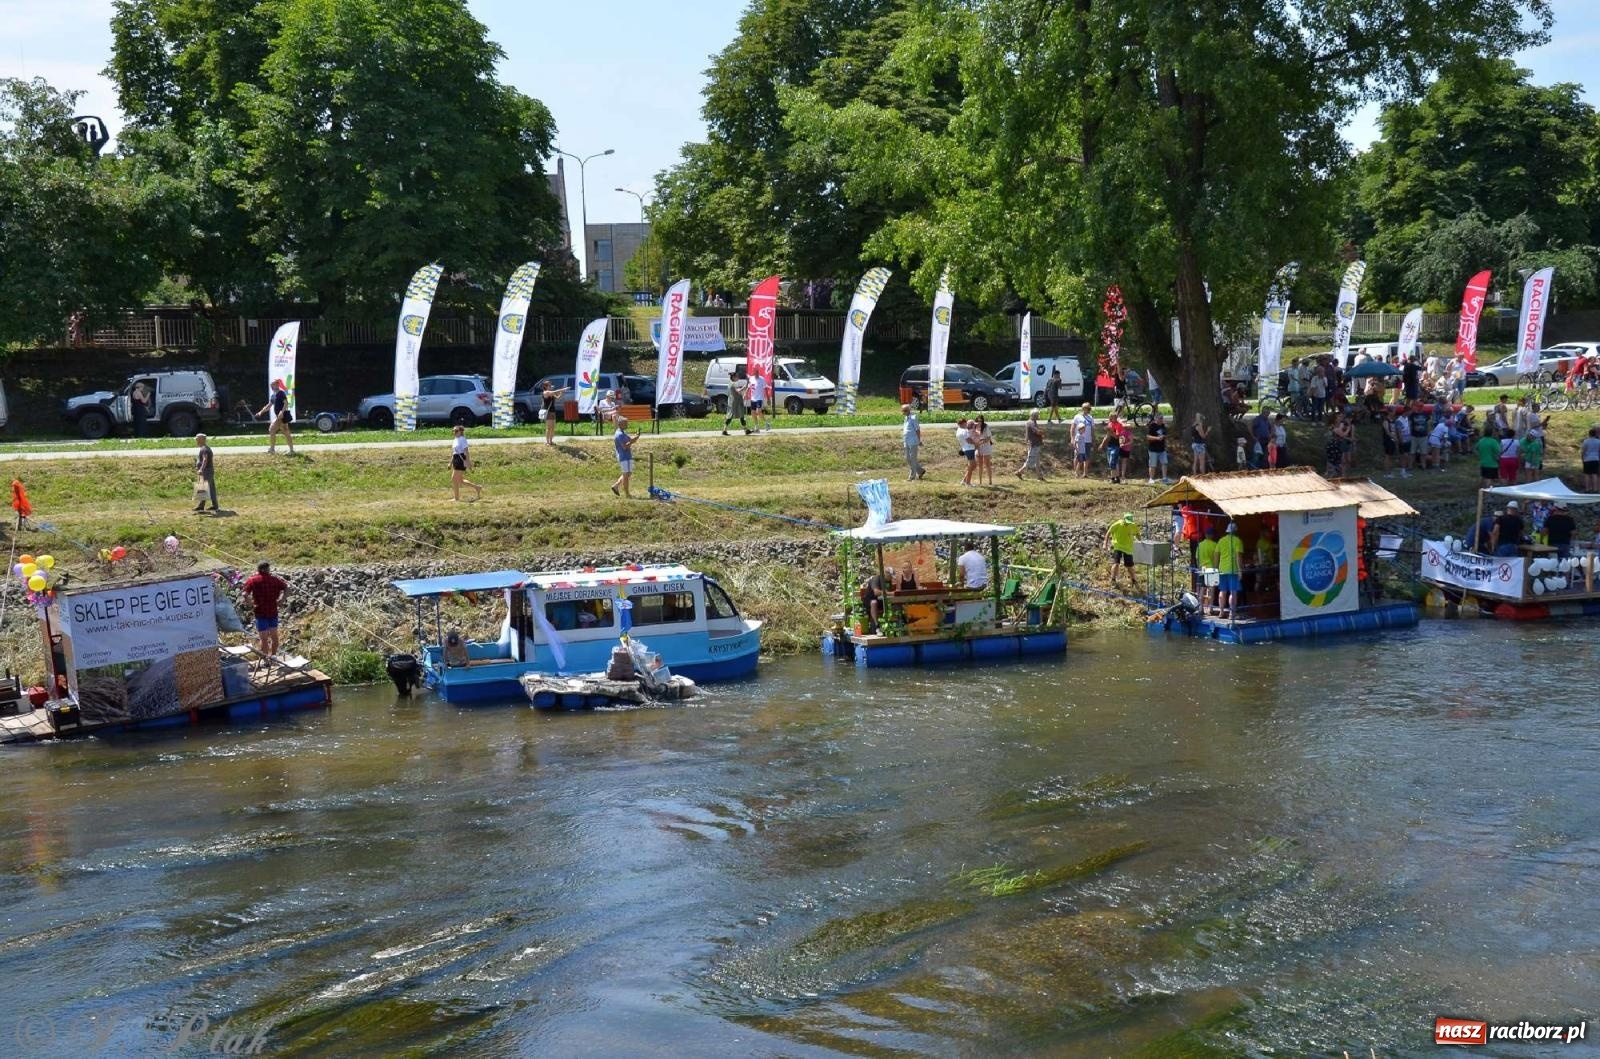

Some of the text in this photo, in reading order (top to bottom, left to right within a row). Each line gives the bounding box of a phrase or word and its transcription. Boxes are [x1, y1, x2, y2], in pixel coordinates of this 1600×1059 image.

[1524, 278, 1545, 351] RACIBÓRZ
[667, 293, 684, 378] RACIBÓRZ
[74, 598, 125, 623] SKLEP
[130, 595, 151, 614] PE
[155, 590, 182, 611] GIE
[185, 585, 211, 607] GIE
[545, 591, 572, 601] MIEJSCE
[632, 582, 686, 594] GMINA CISEK
